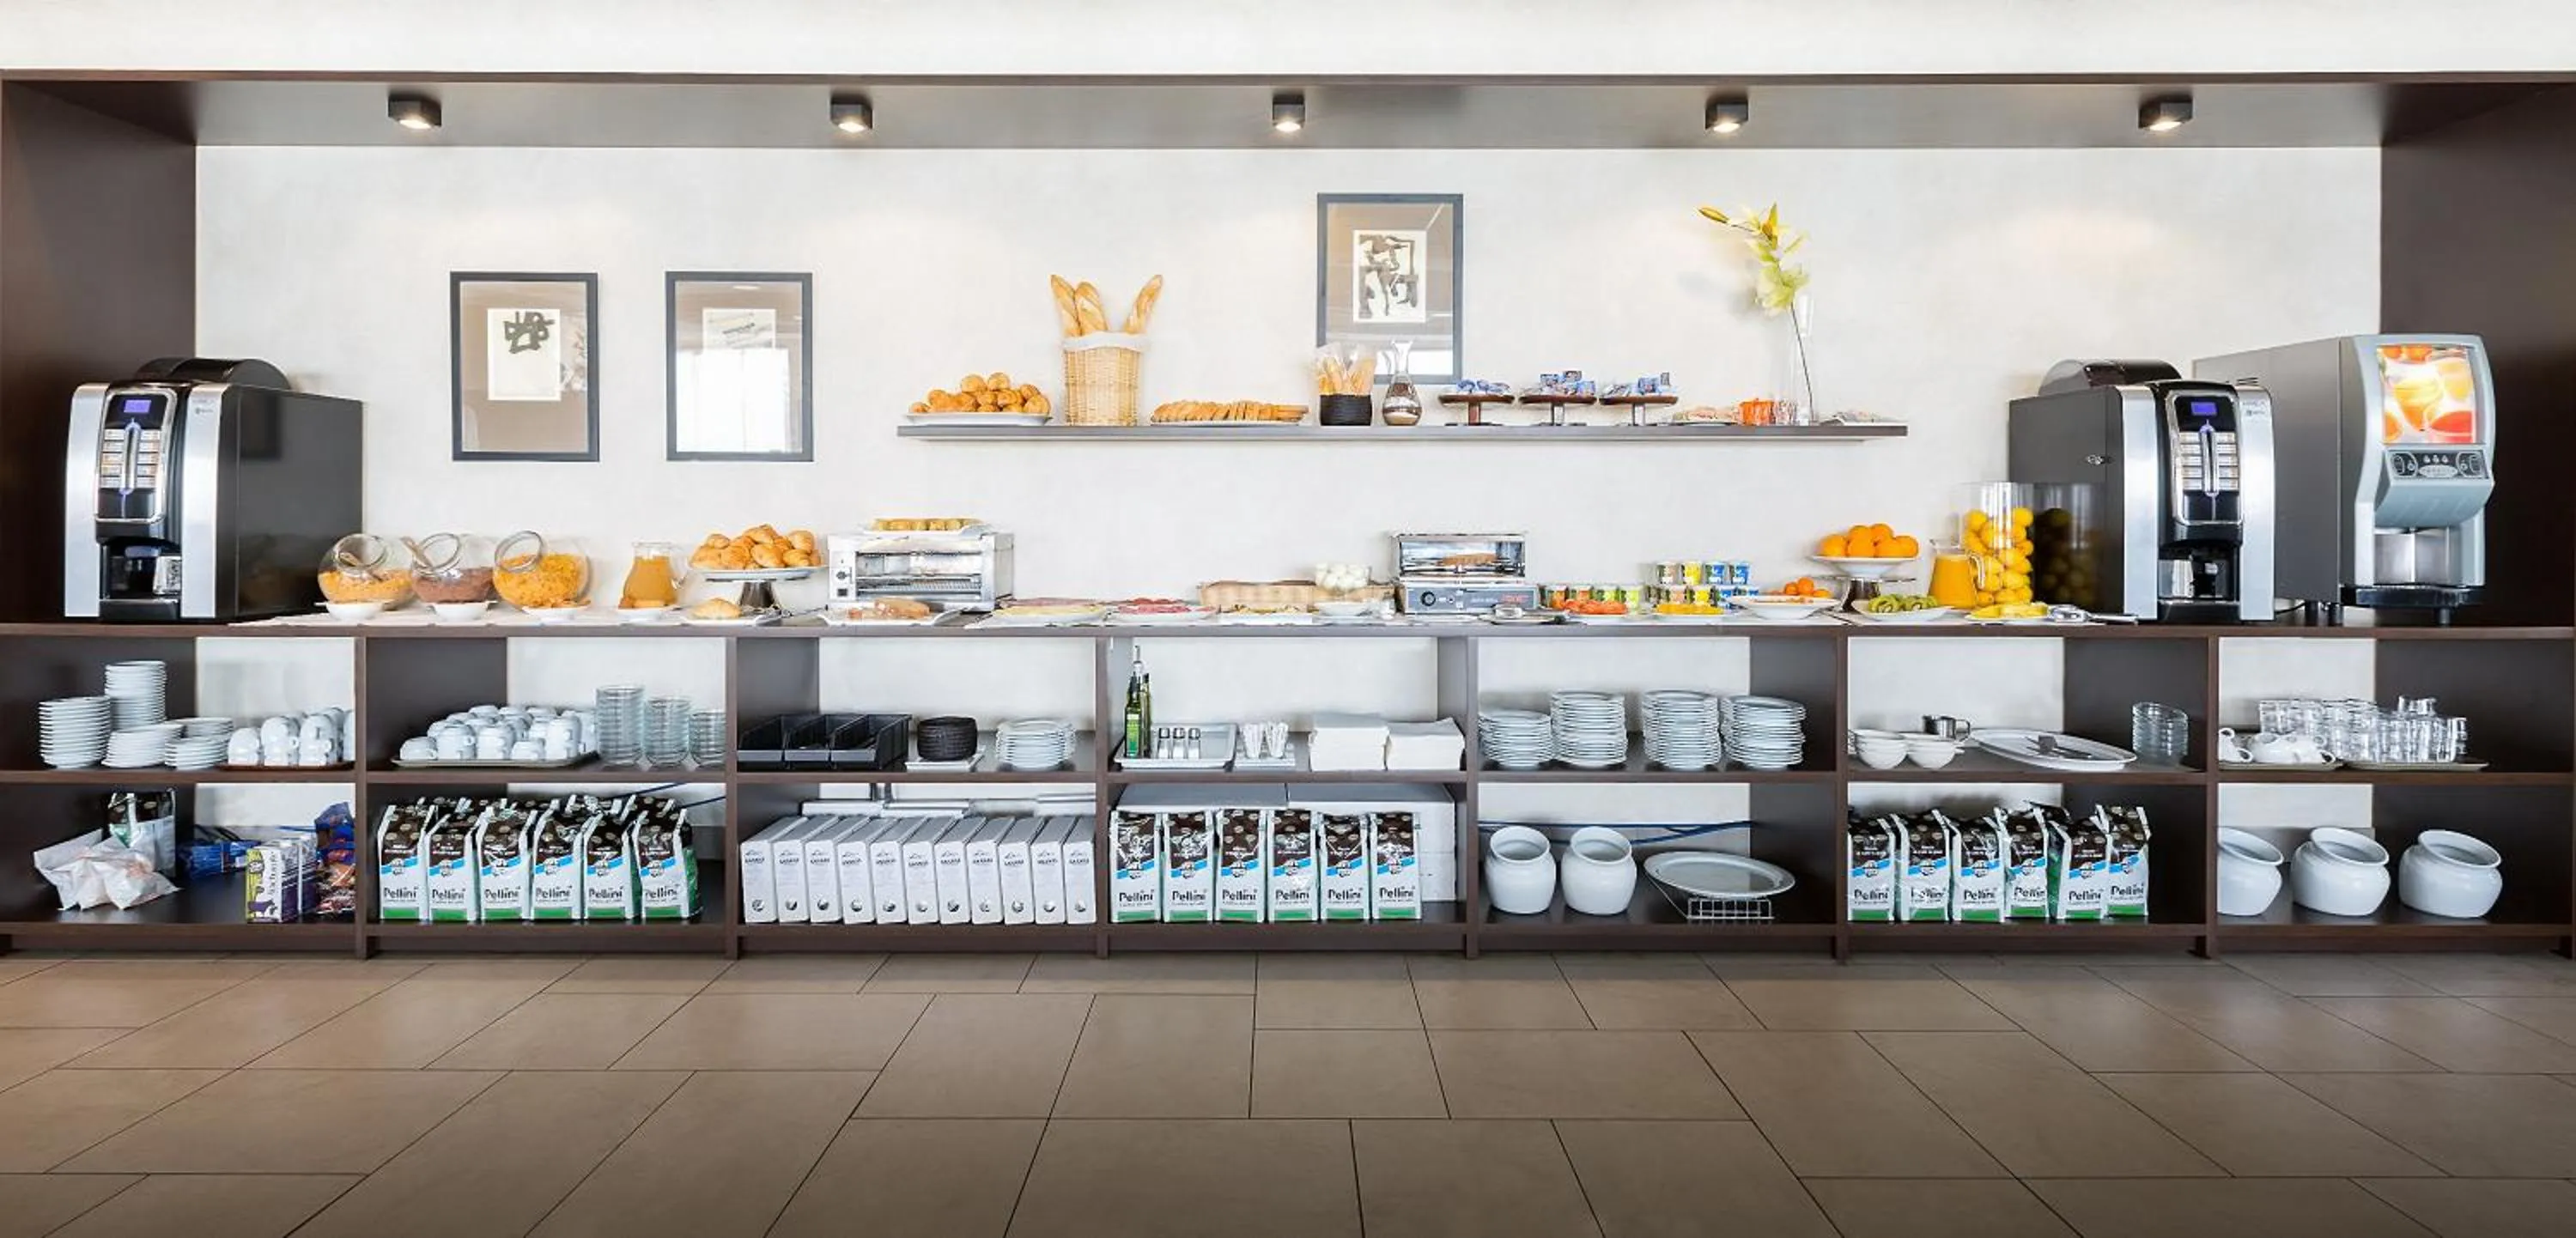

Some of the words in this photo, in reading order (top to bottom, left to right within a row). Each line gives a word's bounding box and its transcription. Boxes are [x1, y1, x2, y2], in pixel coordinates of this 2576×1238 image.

[384, 886, 417, 899] Pellini
[432, 889, 465, 900] Pellini
[484, 886, 520, 900] Pellini
[536, 886, 572, 898] Pellini
[588, 886, 623, 899] Pellini
[1119, 889, 1154, 901] Pellini
[1172, 889, 1207, 901] Pellini
[1222, 889, 1257, 901] Pellini
[1275, 888, 1309, 900] Pellini
[1327, 887, 1363, 900] Pellini
[1379, 886, 1415, 898] Pellini
